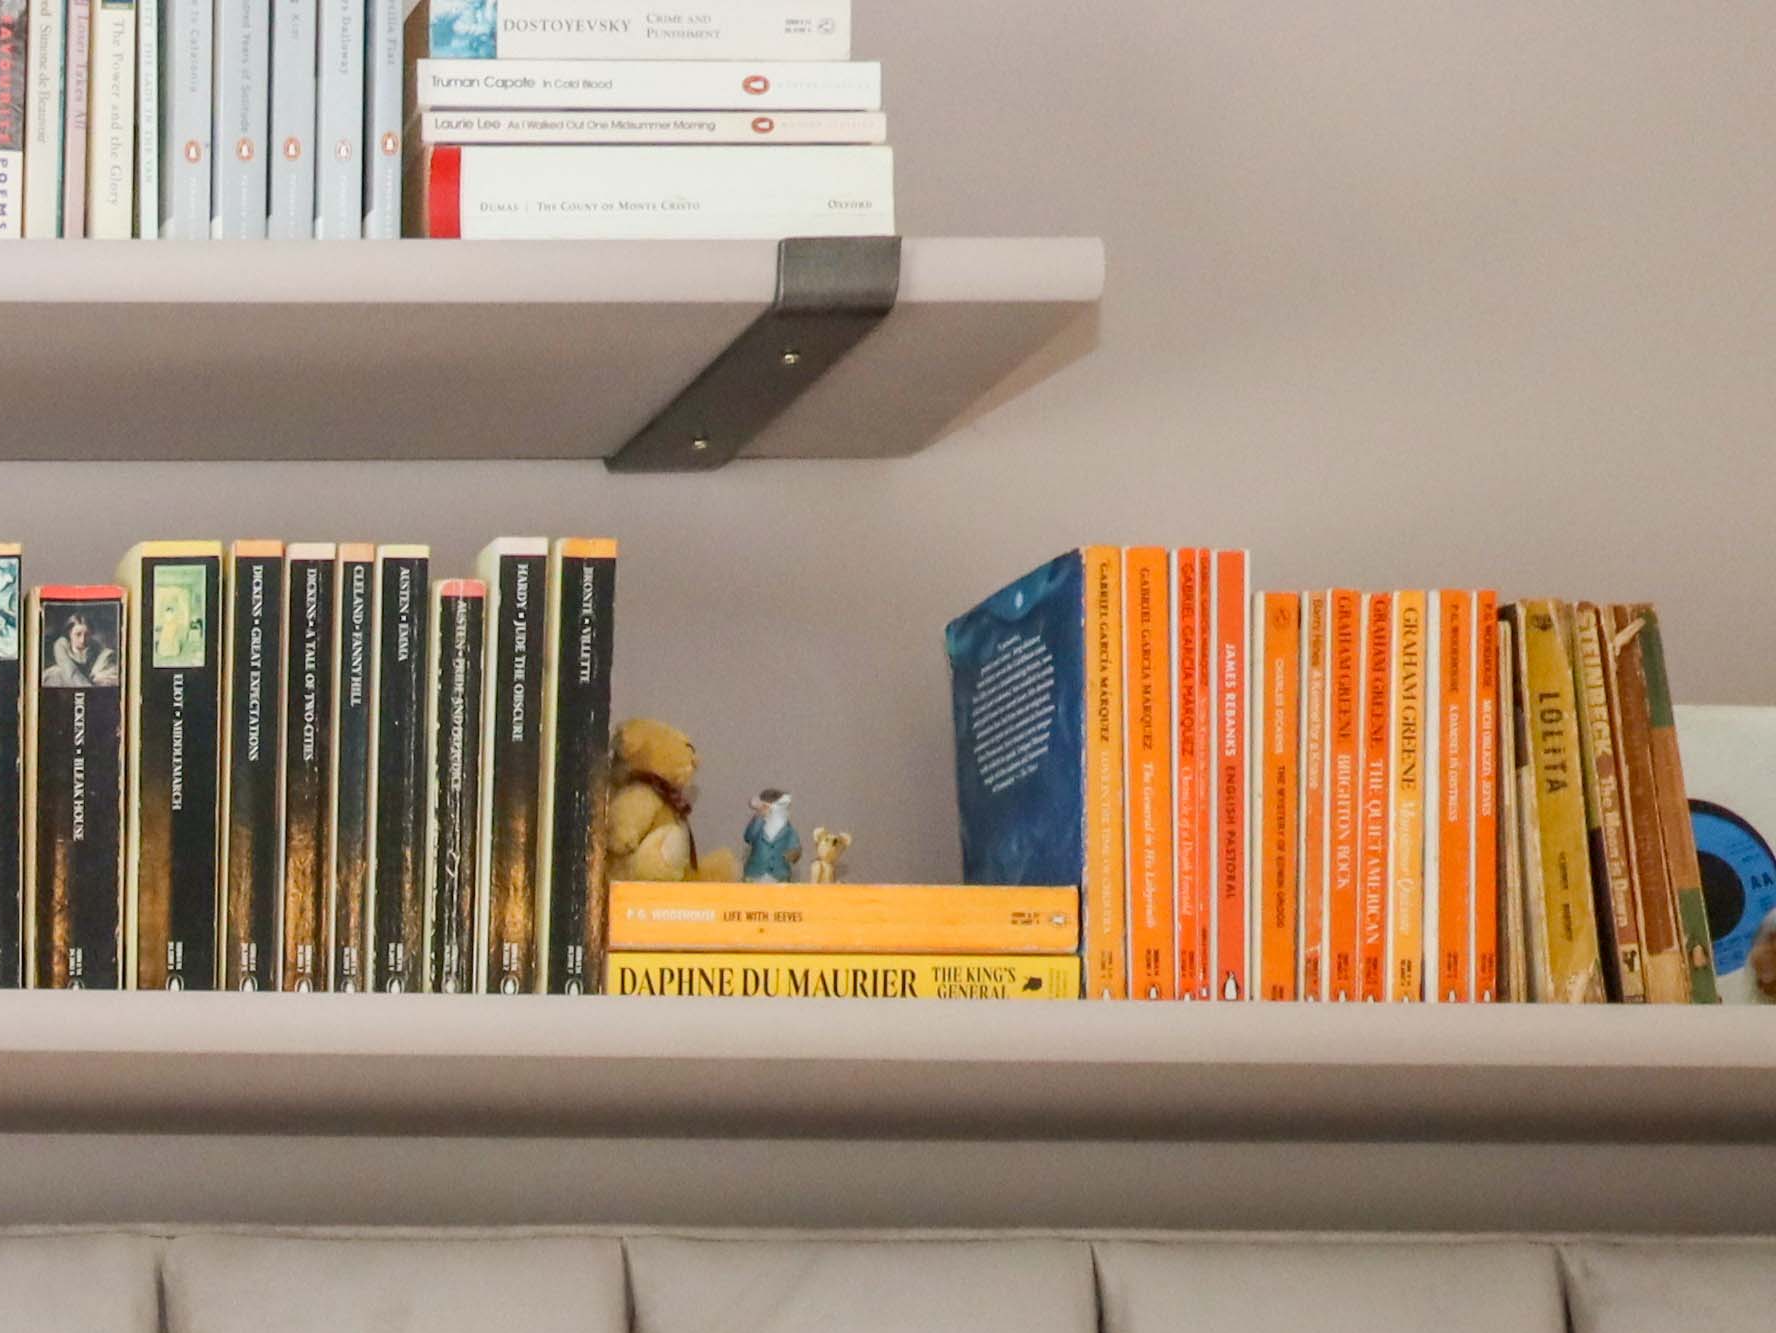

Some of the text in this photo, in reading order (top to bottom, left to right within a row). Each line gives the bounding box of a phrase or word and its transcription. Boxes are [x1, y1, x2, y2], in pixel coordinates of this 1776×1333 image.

[502, 17, 632, 34] DOSTOYEVSKY
[431, 74, 536, 93] Truman Capote
[434, 118, 501, 131] Laurie Lee
[350, 565, 365, 707] CLELAND FANNY HILL
[397, 567, 411, 662] AUSTEN EMMA
[455, 600, 467, 650] AUSTEN
[1099, 562, 1110, 618] GABRIEL
[1140, 567, 1152, 624] GABRIEL
[248, 565, 264, 762] DICKENS GREAT EXPECTATIONS
[302, 568, 318, 762] DICKENS A TALE OF TWO CITIES
[511, 563, 529, 742] HARDY JUDE THE OBSCURE
[578, 626, 592, 685] VILLETTE
[1400, 606, 1418, 791] GRAHAM GREENE
[73, 692, 85, 842] DICKENS BLEAK HOUSE
[171, 673, 184, 811] ELIOT MIDDLEMARCH
[1224, 643, 1236, 899] JAMES REBANKS ENGLISH PASTORAL
[1336, 595, 1353, 889] GRAHAM GREENE BRIGHTON ROCK
[1366, 598, 1389, 945] GRAHAM GREENE THE QUIET AMERICAN
[1576, 609, 1621, 858] STEINBECK The Moon
[722, 911, 769, 922] LIFE WITH
[619, 966, 919, 999] DAPHNE DU MAURIER
[932, 966, 1017, 983] THE KING'S
[936, 984, 1009, 1000] GENERAL
